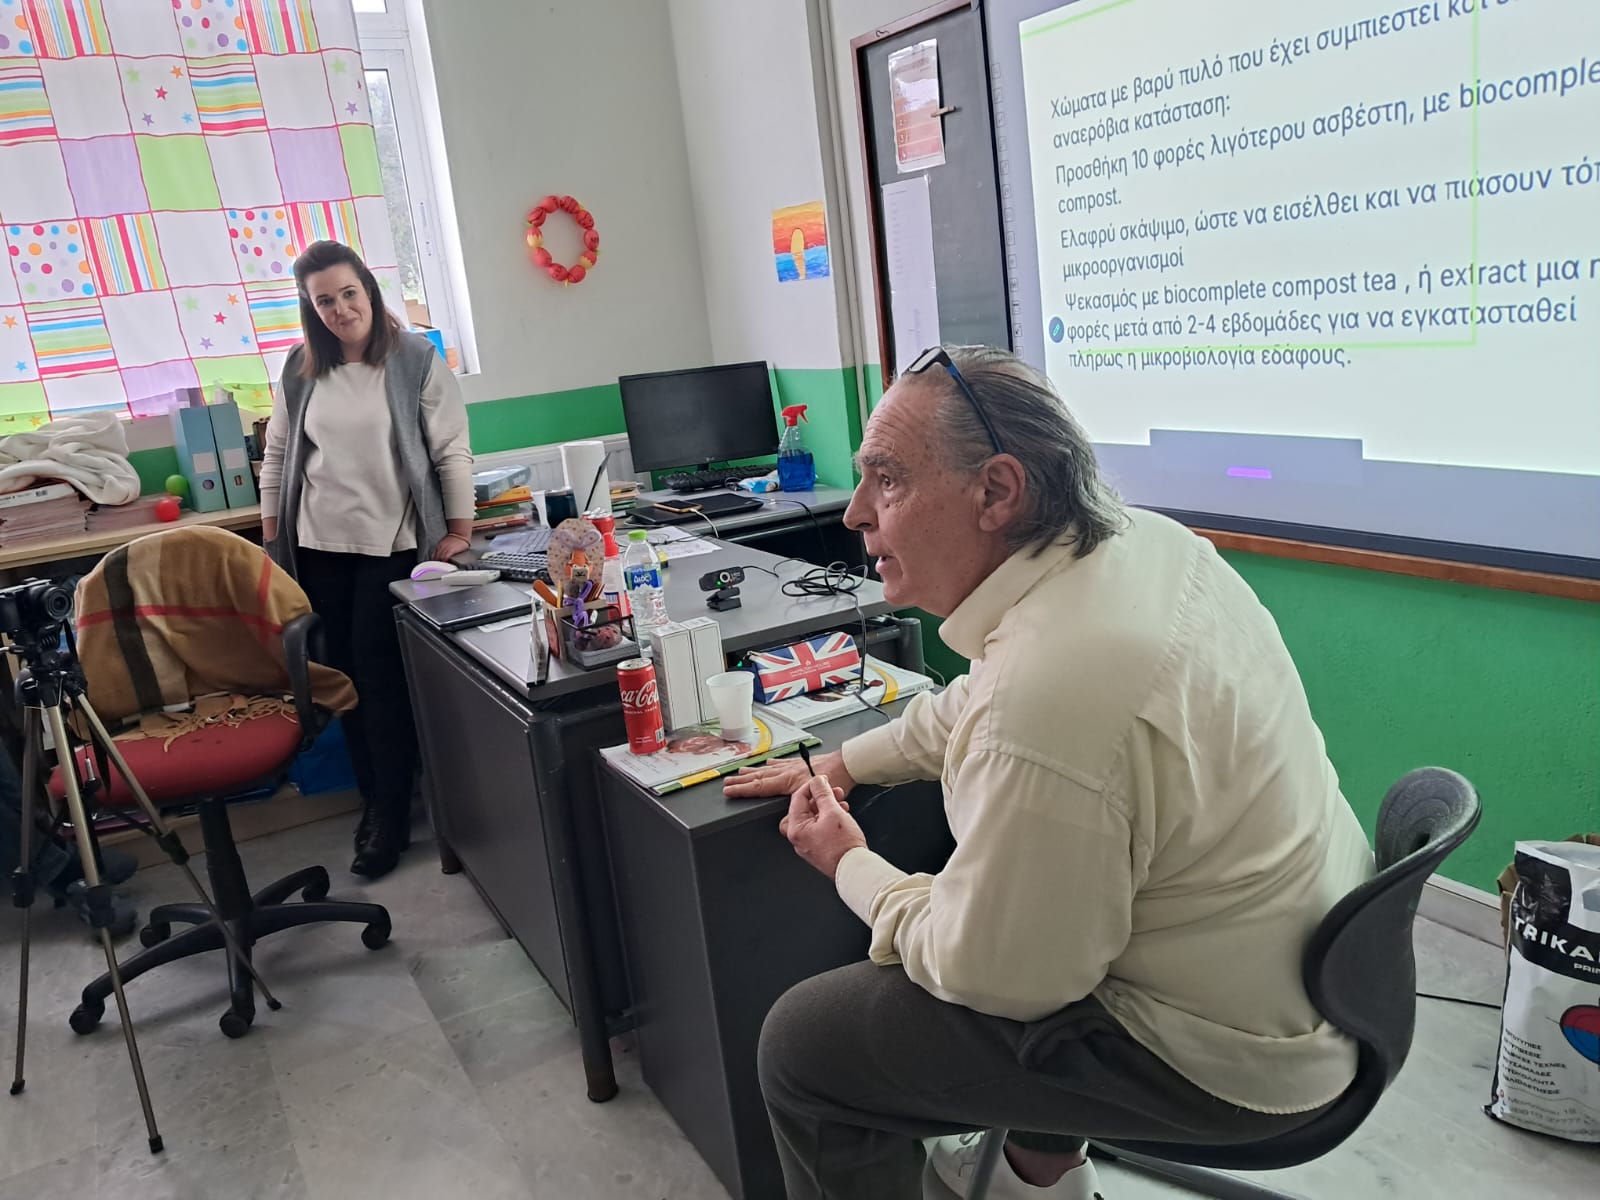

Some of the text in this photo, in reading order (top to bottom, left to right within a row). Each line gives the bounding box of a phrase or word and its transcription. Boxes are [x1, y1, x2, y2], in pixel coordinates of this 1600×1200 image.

[1051, 90, 1107, 118] Χώματα
[1111, 85, 1128, 108] με
[1133, 68, 1174, 102] βαρύ
[1180, 54, 1223, 86] πυλό
[1229, 48, 1263, 73] που
[1269, 36, 1310, 66] έχει
[1053, 94, 1230, 148] αναερόβια κατάσταση:
[1055, 155, 1128, 187] Προσθήκη
[1132, 148, 1149, 171] 10
[1153, 138, 1205, 170] φορές
[1210, 120, 1306, 157] λιγότερου
[1312, 100, 1415, 136] ασβέστη,
[1423, 92, 1450, 122] με
[1058, 188, 1122, 217] compost.
[1060, 222, 1116, 249] Ελαφρύ
[1120, 217, 1190, 245] σκάψιμο,
[1195, 209, 1238, 232] ώστε
[1244, 207, 1267, 225] να
[1273, 192, 1359, 222] εισέλθει
[1366, 188, 1400, 211] και
[1407, 184, 1436, 205] να
[1445, 168, 1553, 201] πιάσουν
[1062, 246, 1184, 282] μικροοργανισμοί
[1065, 288, 1137, 312] Ψεκασμός
[1142, 289, 1160, 311] με
[1164, 280, 1267, 306] biocomplete
[1272, 272, 1357, 300] compost
[1363, 271, 1396, 292] tea
[1418, 264, 1431, 294] ή
[1440, 259, 1527, 288] extract
[1536, 258, 1580, 288] μια
[1067, 295, 1577, 343] φορές μετά από 2-4 εβδομάδες για να εγκατασταθεί
[1069, 343, 1351, 371] πλήρως η μικροβιολογία εδάφους.
[1514, 916, 1600, 963] TRIKA
